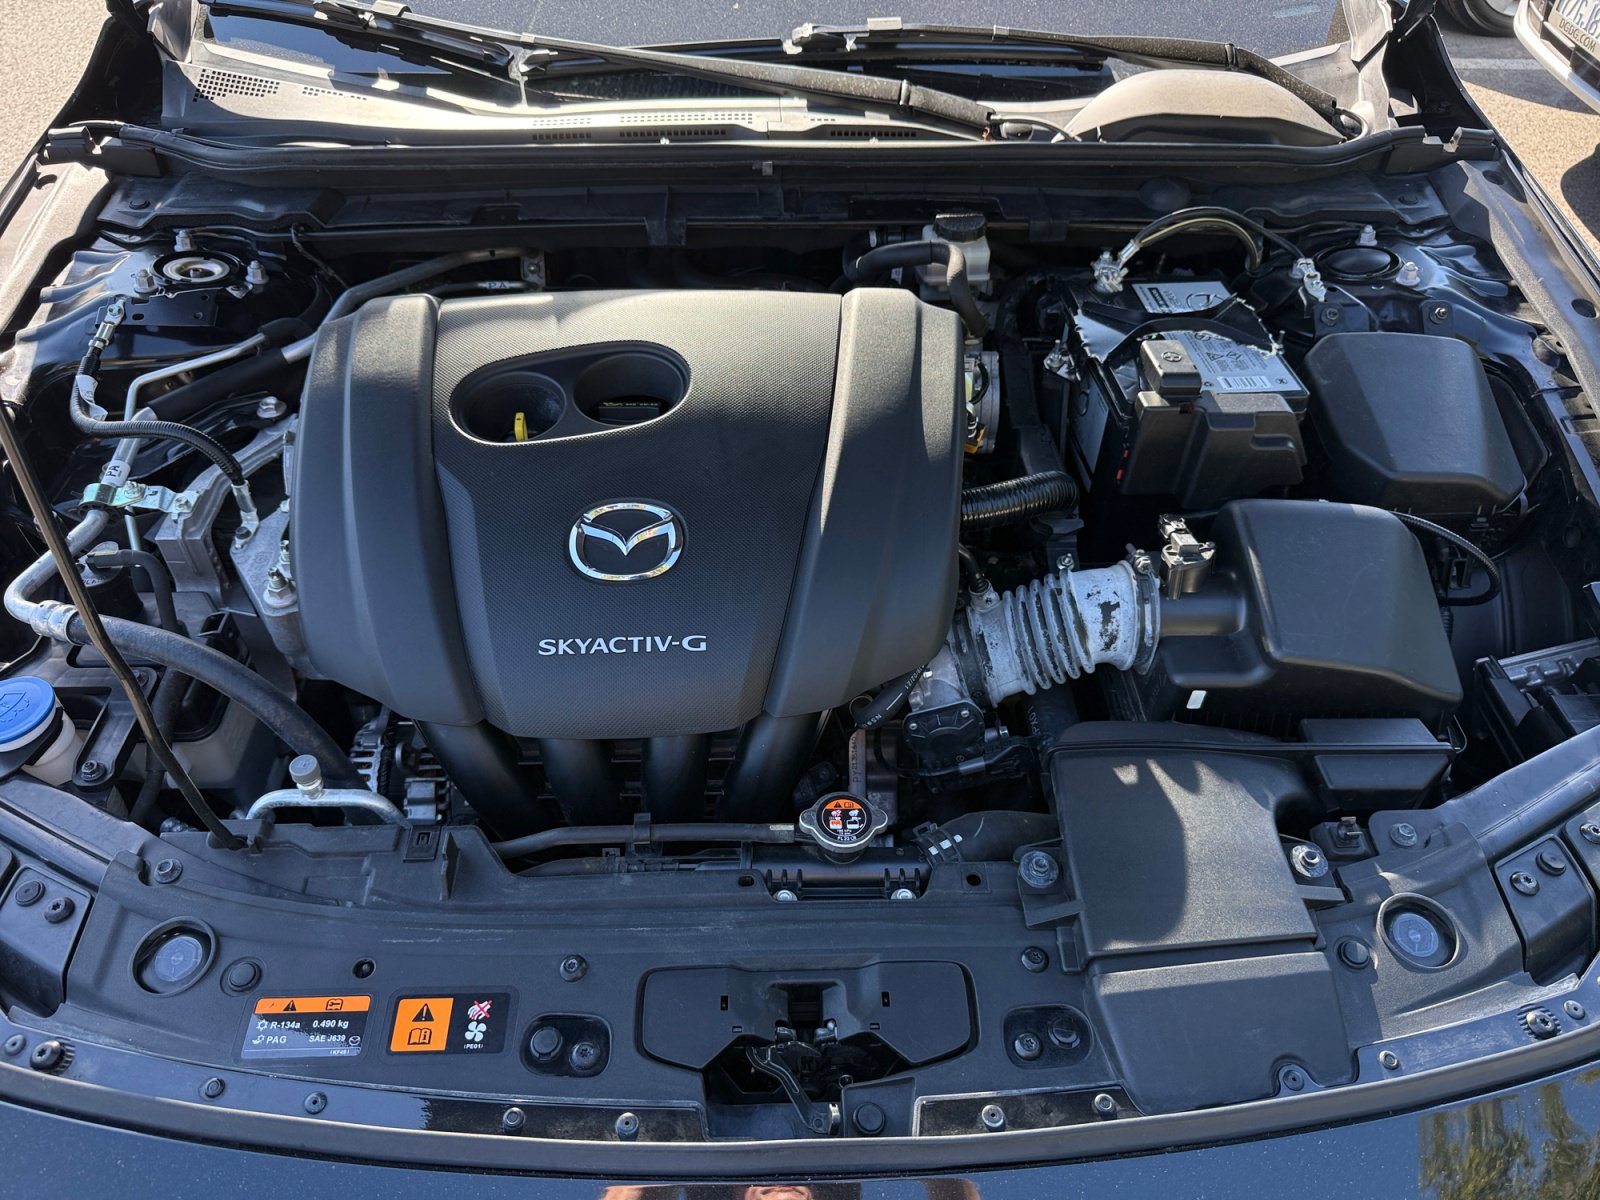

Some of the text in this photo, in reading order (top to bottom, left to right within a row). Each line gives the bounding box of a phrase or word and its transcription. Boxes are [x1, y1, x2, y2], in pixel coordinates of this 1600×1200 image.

[1559, 18, 1596, 52] DGDG.COM
[105, 465, 120, 477] PA
[538, 635, 706, 655] SKYACTIV-G
[270, 1020, 349, 1029] R-134a 0.490 kg
[266, 1035, 287, 1044] PAG
